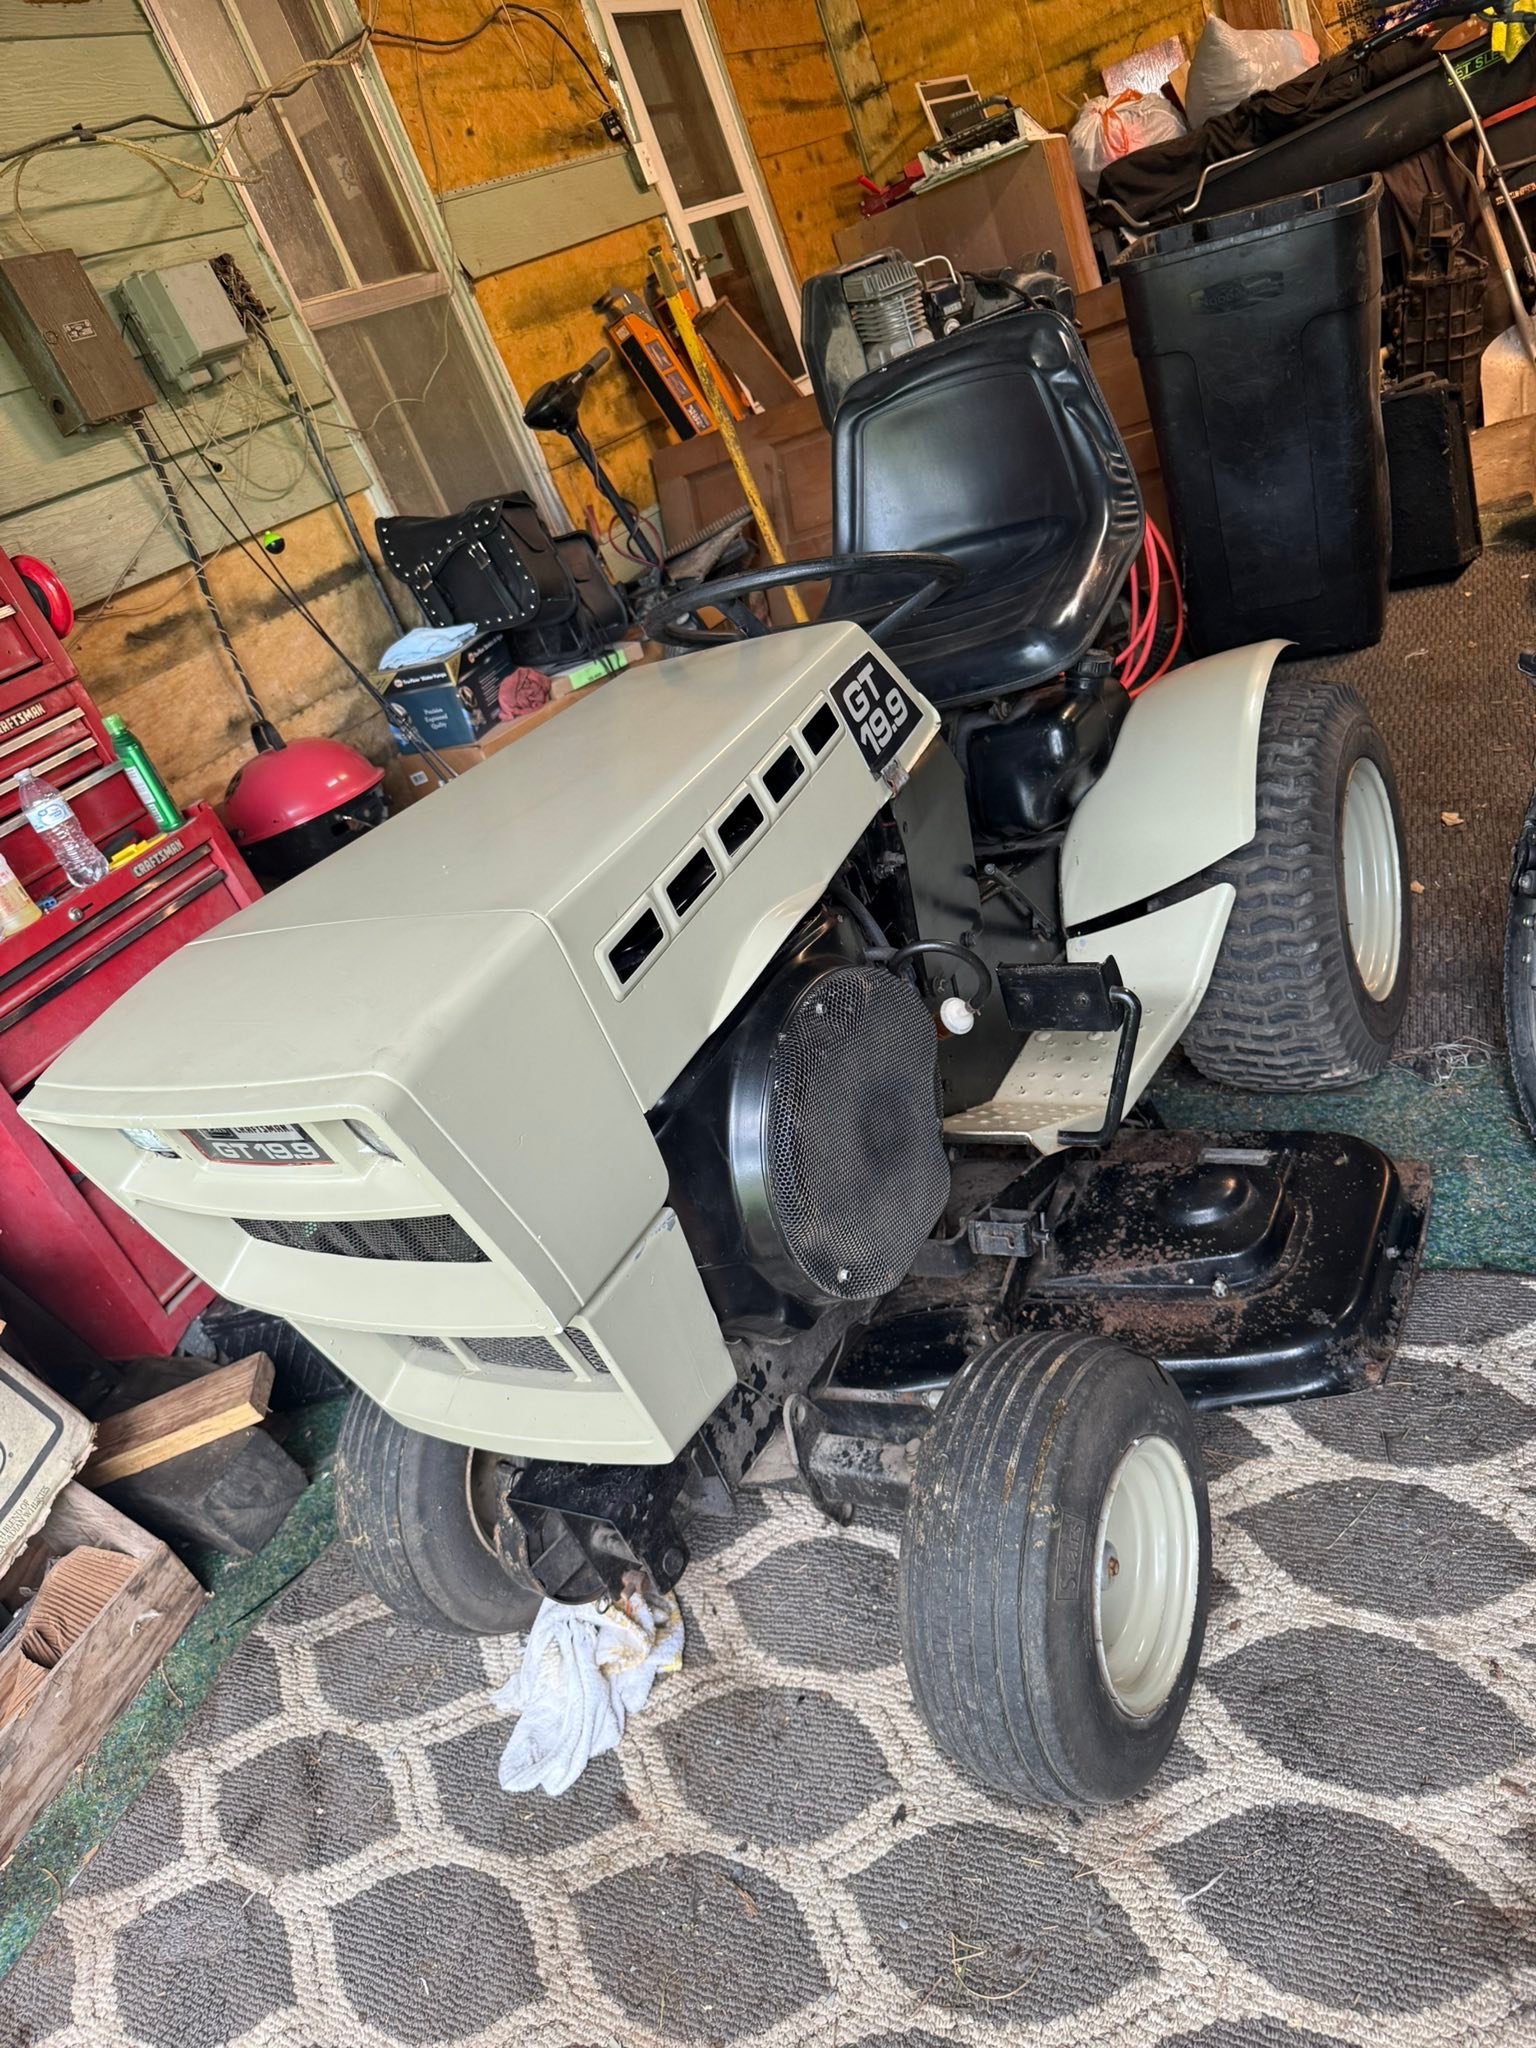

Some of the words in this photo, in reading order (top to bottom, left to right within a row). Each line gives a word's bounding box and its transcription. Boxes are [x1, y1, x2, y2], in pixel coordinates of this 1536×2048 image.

[1475, 51, 1500, 69] SLE
[843, 662, 880, 723] GT
[860, 687, 908, 755] 19.9
[132, 838, 185, 877] CRAFTSMAN
[212, 1142, 254, 1159] GT
[254, 1142, 320, 1160] 19.9
[2, 1508, 24, 1532] BLEND
[20, 1498, 30, 1511] OF
